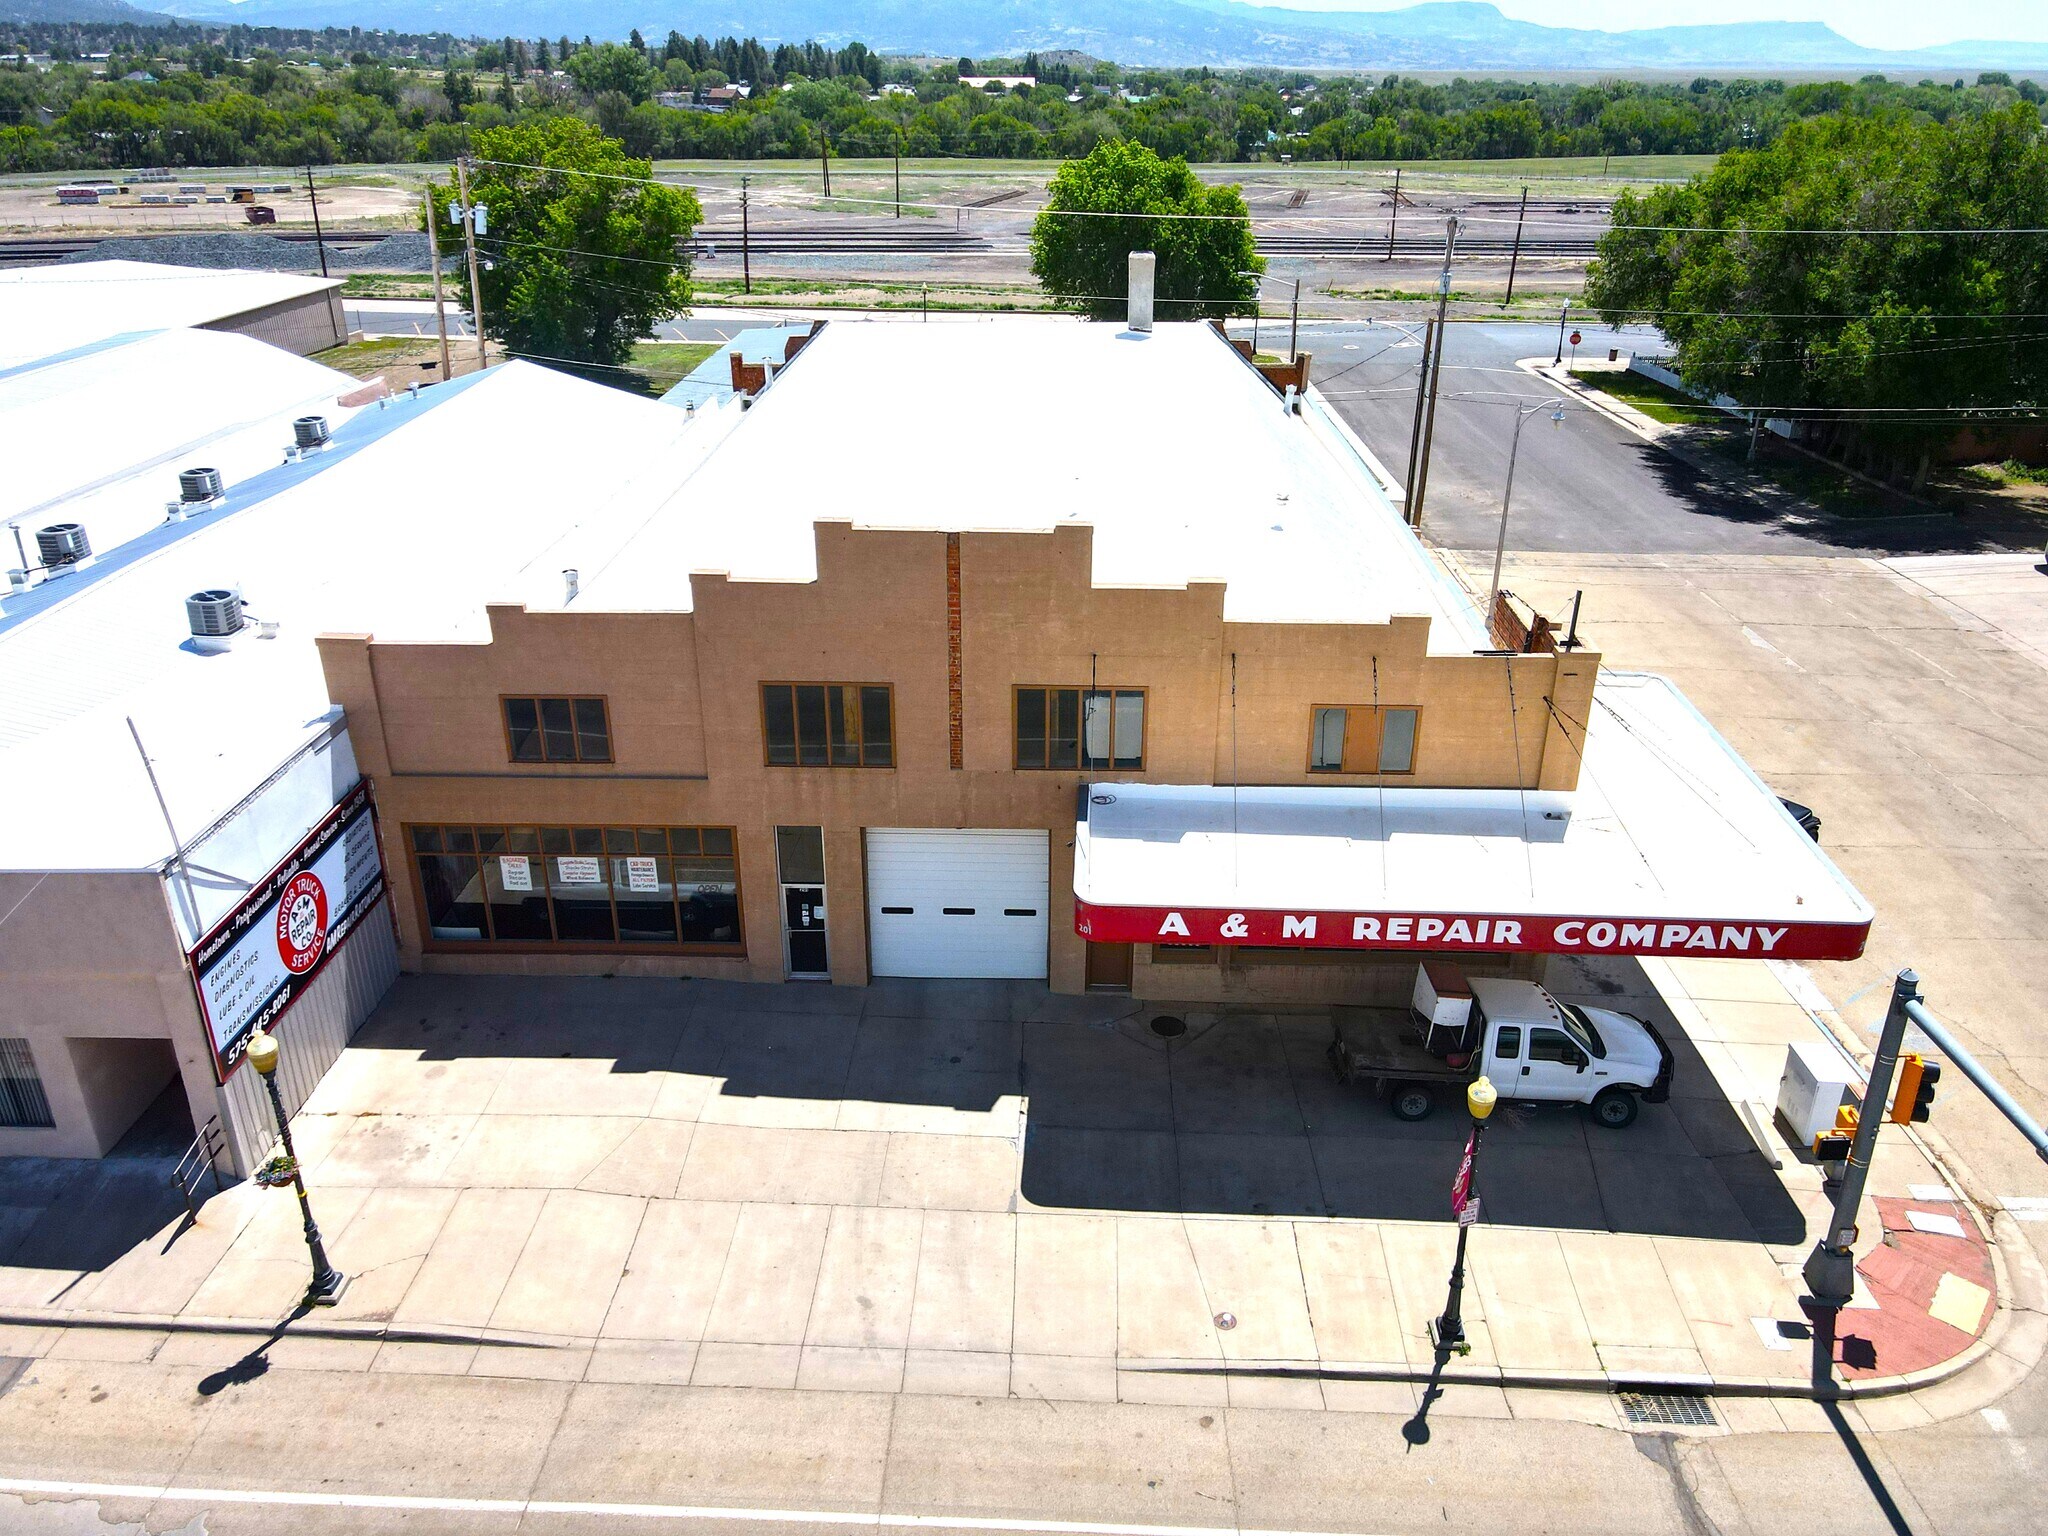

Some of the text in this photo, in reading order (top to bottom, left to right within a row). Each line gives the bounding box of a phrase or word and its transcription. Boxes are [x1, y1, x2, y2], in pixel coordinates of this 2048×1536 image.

[198, 929, 231, 966] Hometown
[235, 883, 272, 929] Professional
[277, 859, 300, 888] Reliable
[304, 836, 321, 861] Honest
[320, 821, 338, 844] Service
[279, 878, 321, 940] MOTOR TRUCK
[291, 911, 298, 922] A
[302, 896, 310, 910] M
[697, 884, 723, 894] OPEN
[291, 908, 316, 943] REPAIR
[1078, 921, 1092, 935] 201
[1158, 912, 1788, 951] A & M REPAIR COMPANY
[210, 949, 240, 987] ENGINES
[291, 928, 324, 968] SERVICE
[214, 950, 259, 1003] DIAGNOSTICS
[219, 974, 255, 1020] LUBE & OIL
[223, 975, 278, 1040] TRANSMISSIONS
[228, 984, 291, 1065] 575-445-8061
